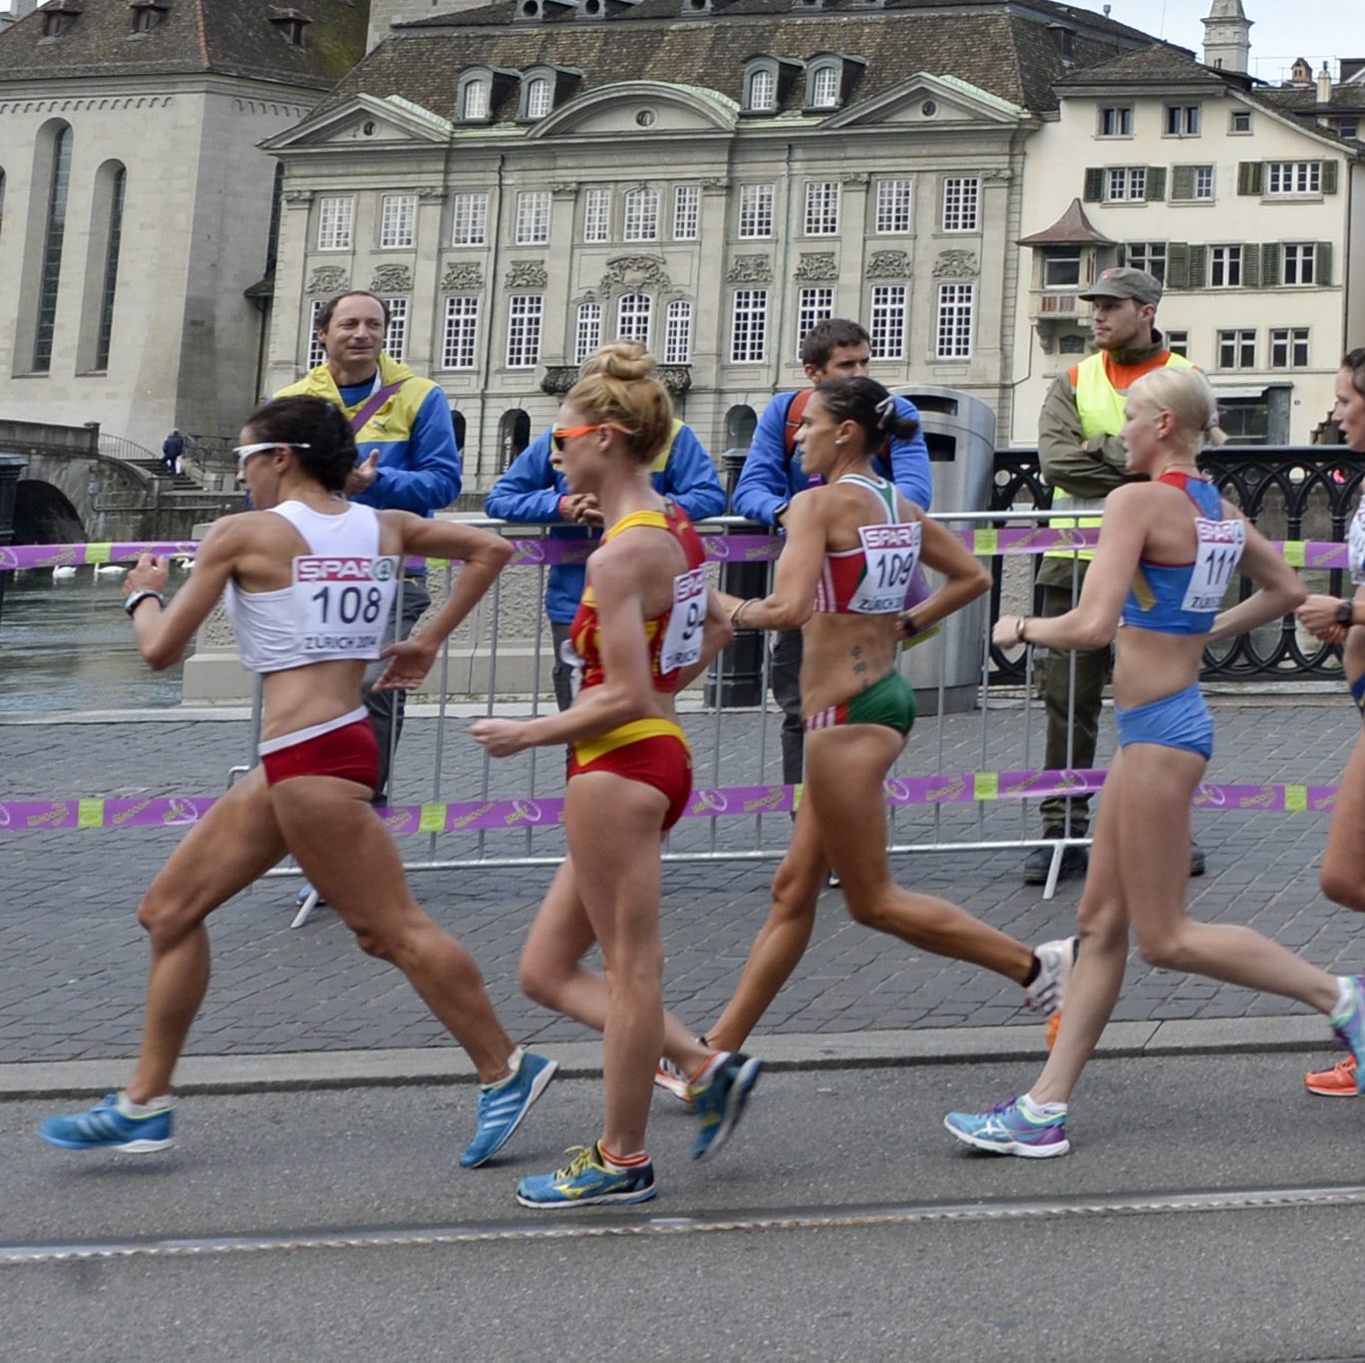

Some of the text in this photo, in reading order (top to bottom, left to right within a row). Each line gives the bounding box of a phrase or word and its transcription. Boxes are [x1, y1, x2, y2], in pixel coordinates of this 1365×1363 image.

[864, 527, 911, 547] SPAR
[299, 559, 372, 580] SPAR
[876, 552, 914, 589] 109
[1205, 548, 1237, 585] 111
[312, 586, 382, 624] 108
[682, 602, 705, 641] 9
[303, 633, 356, 650] ZÜRICH
